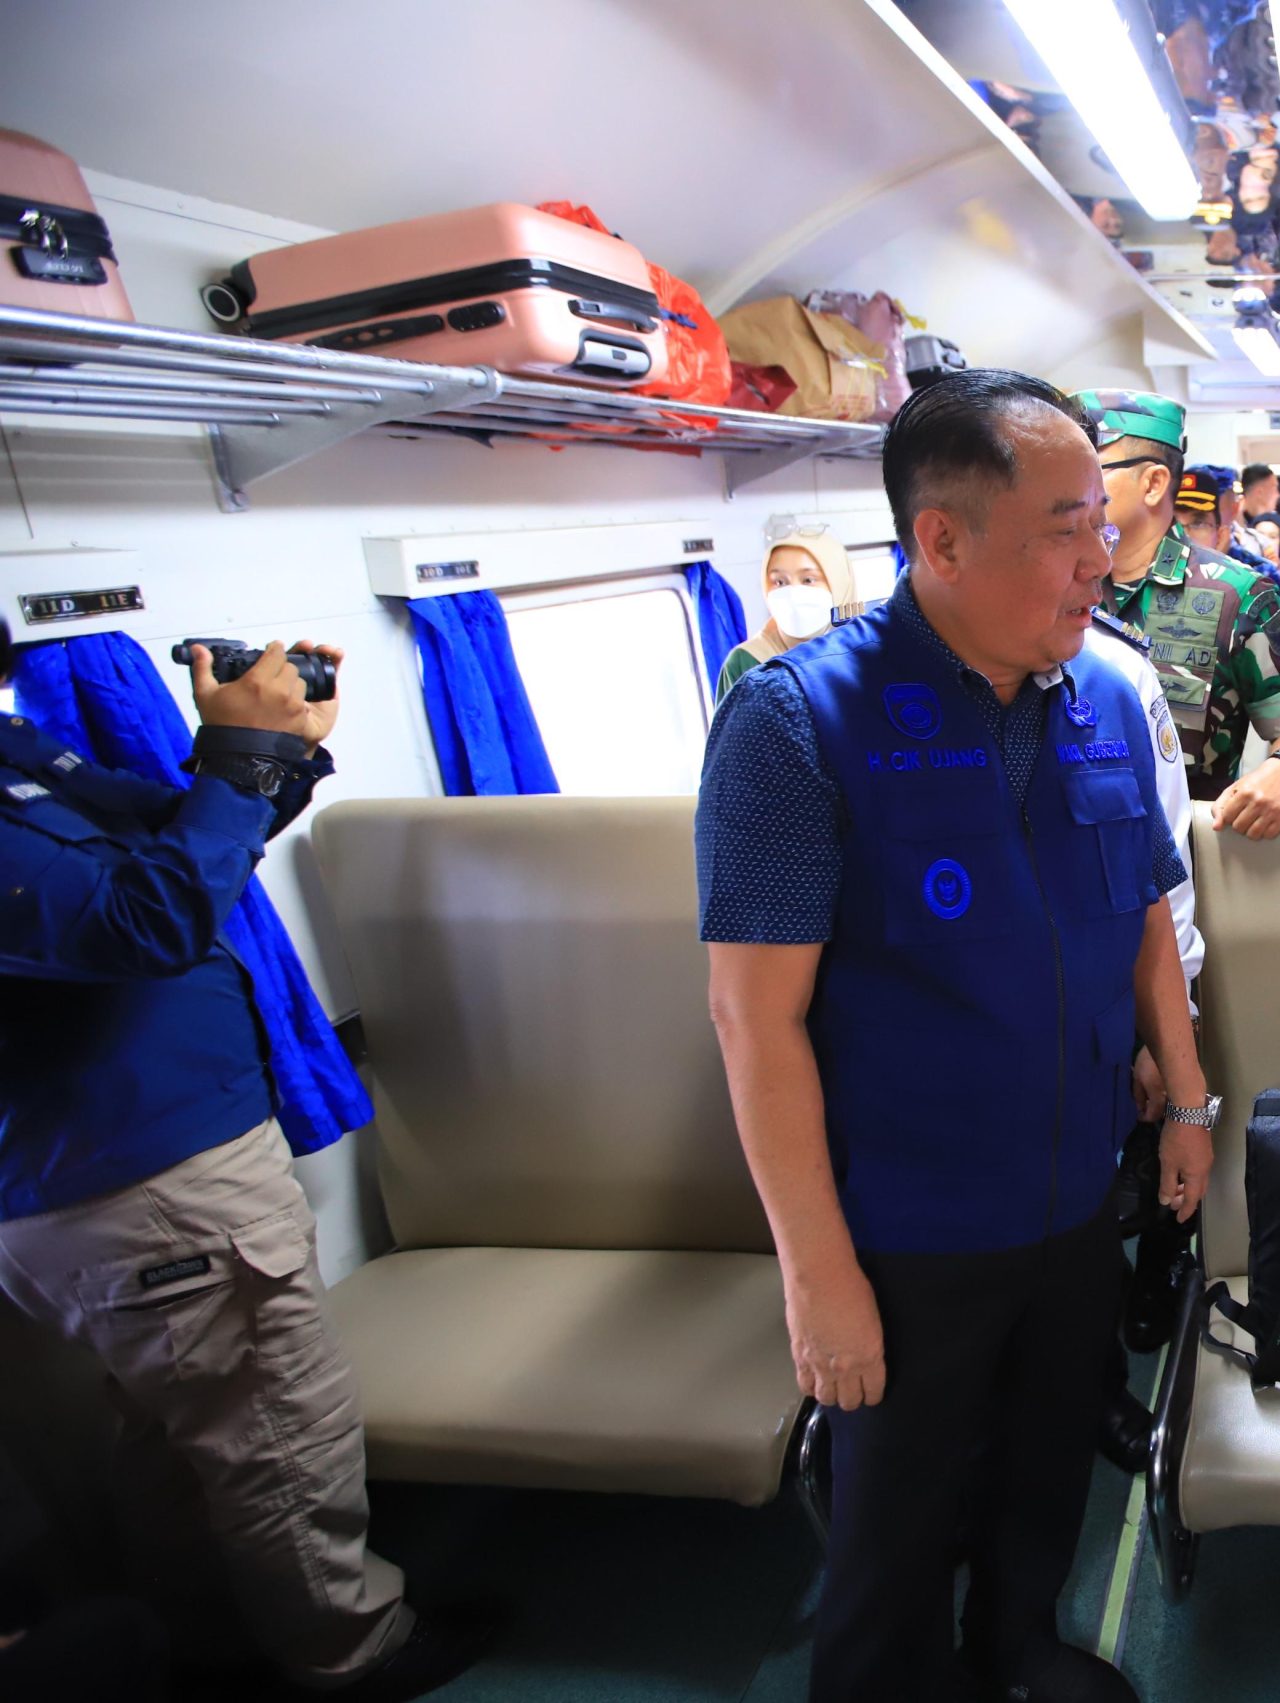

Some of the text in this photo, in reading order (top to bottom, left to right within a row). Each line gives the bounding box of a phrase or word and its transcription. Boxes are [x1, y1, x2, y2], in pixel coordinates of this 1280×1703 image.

[39, 593, 129, 614] 11D 11E
[1150, 642, 1212, 667] NI AD
[929, 748, 987, 768] UJANG
